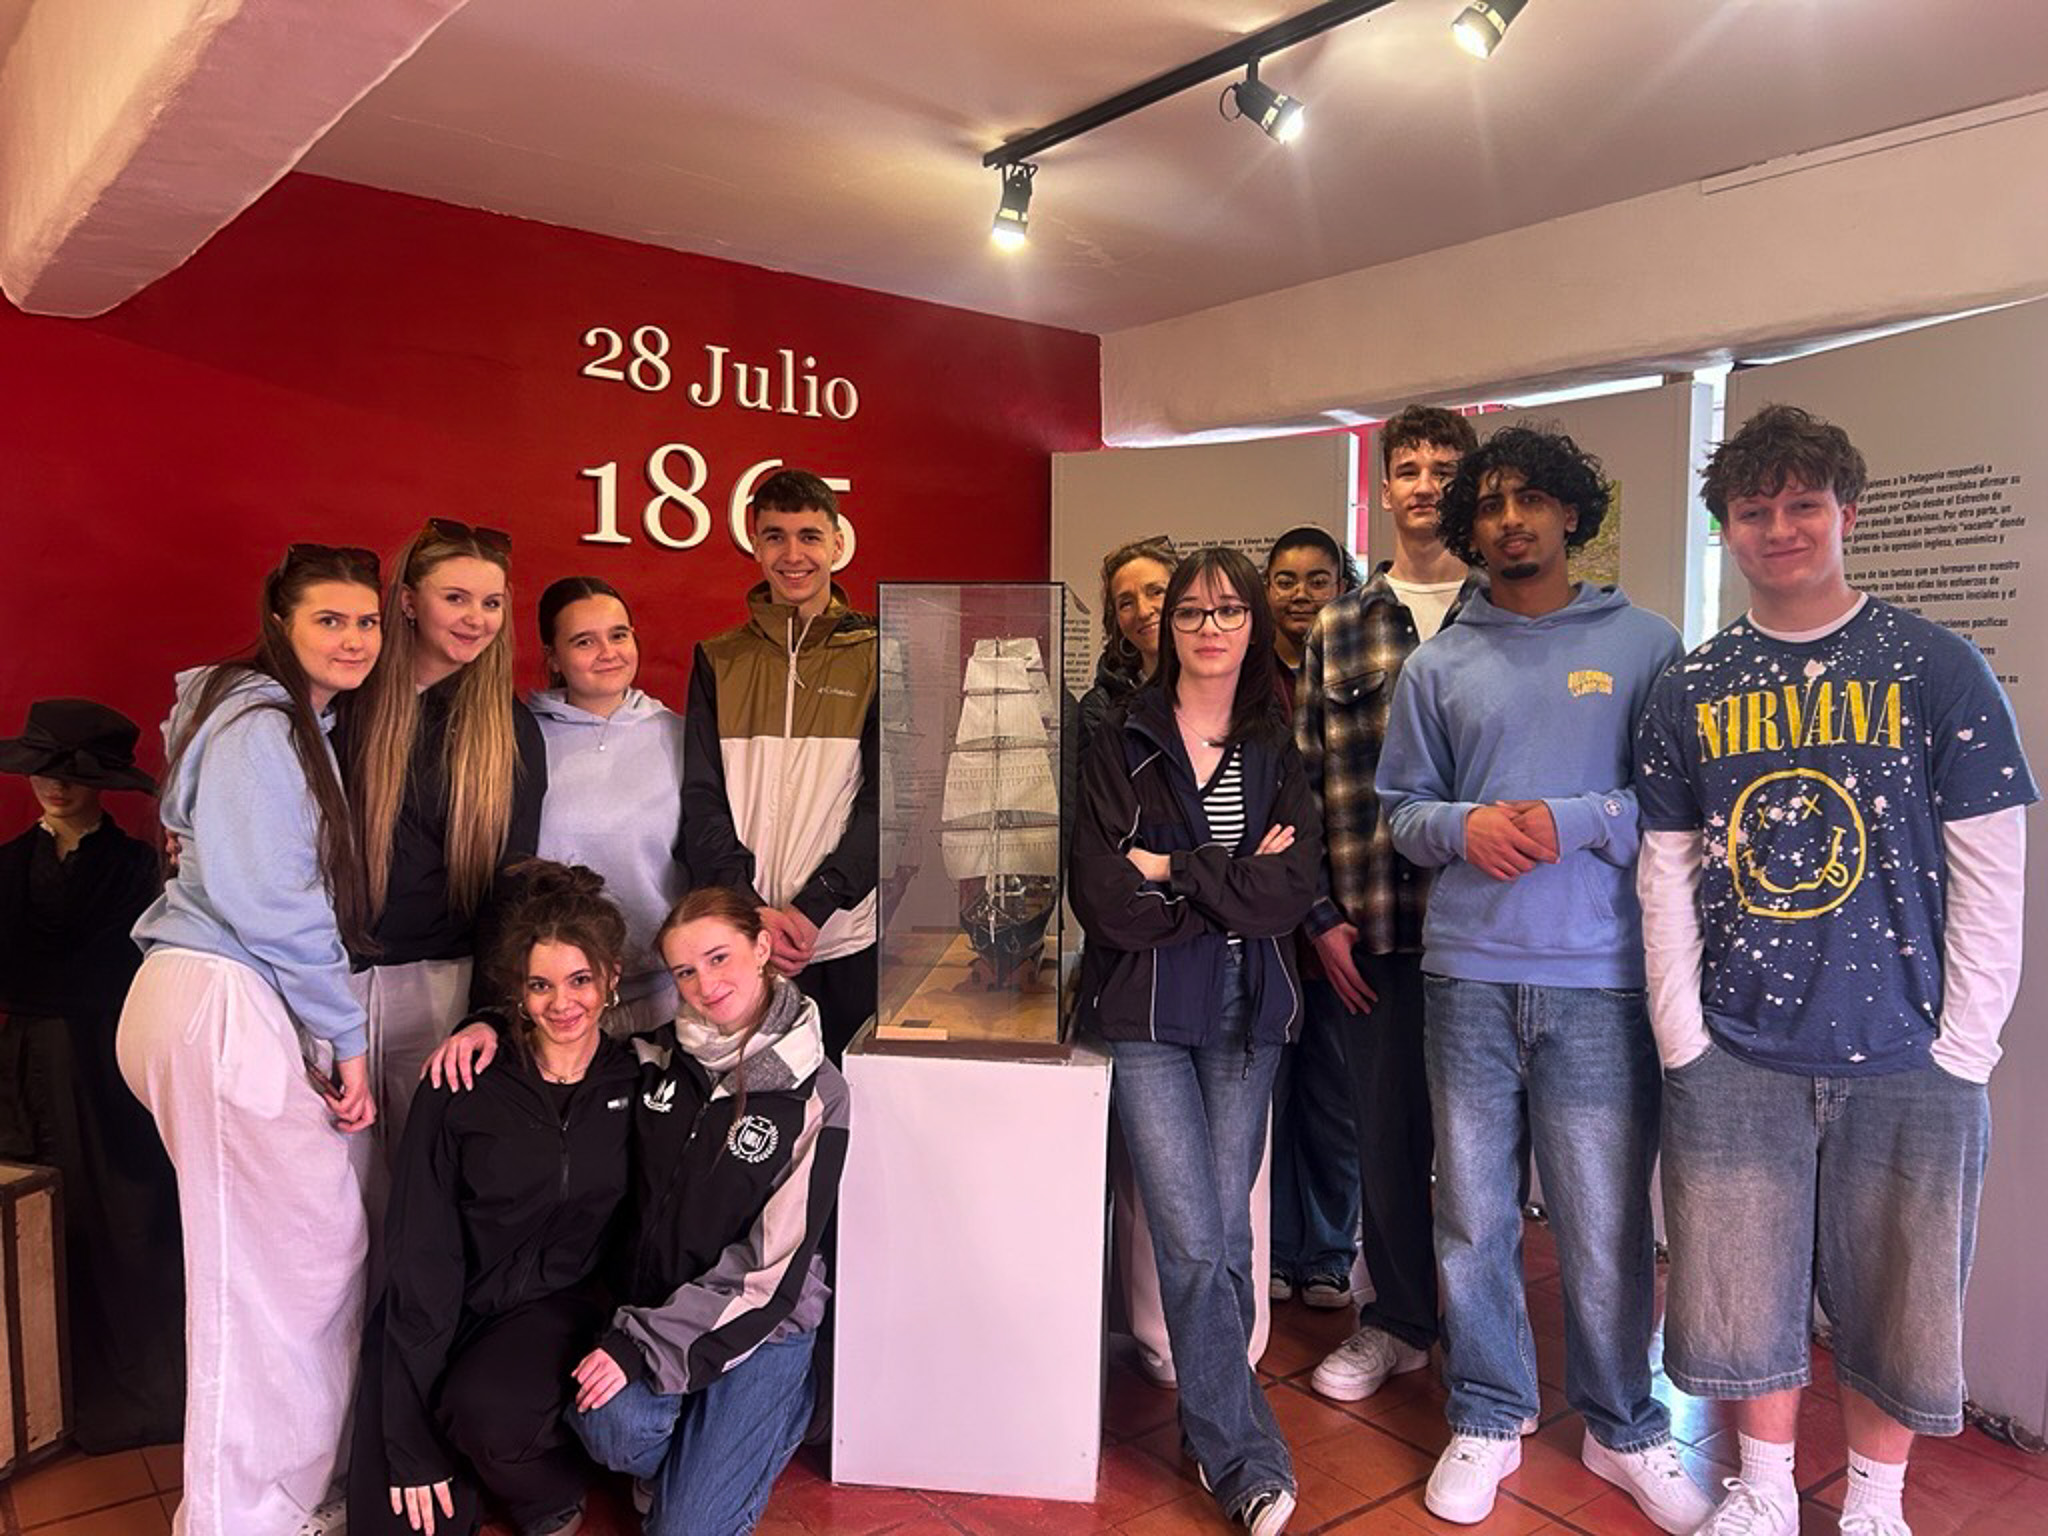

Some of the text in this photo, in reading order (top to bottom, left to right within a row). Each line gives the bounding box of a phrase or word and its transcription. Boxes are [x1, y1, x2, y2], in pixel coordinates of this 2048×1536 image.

[582, 325, 860, 420] 28 Julio
[1908, 470, 1945, 484] Patagonia
[1867, 491, 1899, 504] gobierno
[1900, 486, 1934, 500] argentino
[1936, 480, 1977, 493] necesitaba
[1980, 477, 2009, 488] afirmar
[1888, 503, 1900, 515] por
[1902, 500, 1921, 511] Chile
[1923, 498, 1944, 508] desde
[1946, 496, 1954, 506] el
[1956, 492, 1990, 505] Estrecho
[1992, 491, 2002, 501] de
[1943, 509, 1956, 519] Por
[1958, 508, 1974, 519] otra
[1923, 522, 1958, 535] territorio
[2000, 516, 2025, 528] donde
[1989, 560, 2020, 571] nuestro
[1989, 575, 2000, 585] de
[1695, 679, 1904, 763] NIRVANA
